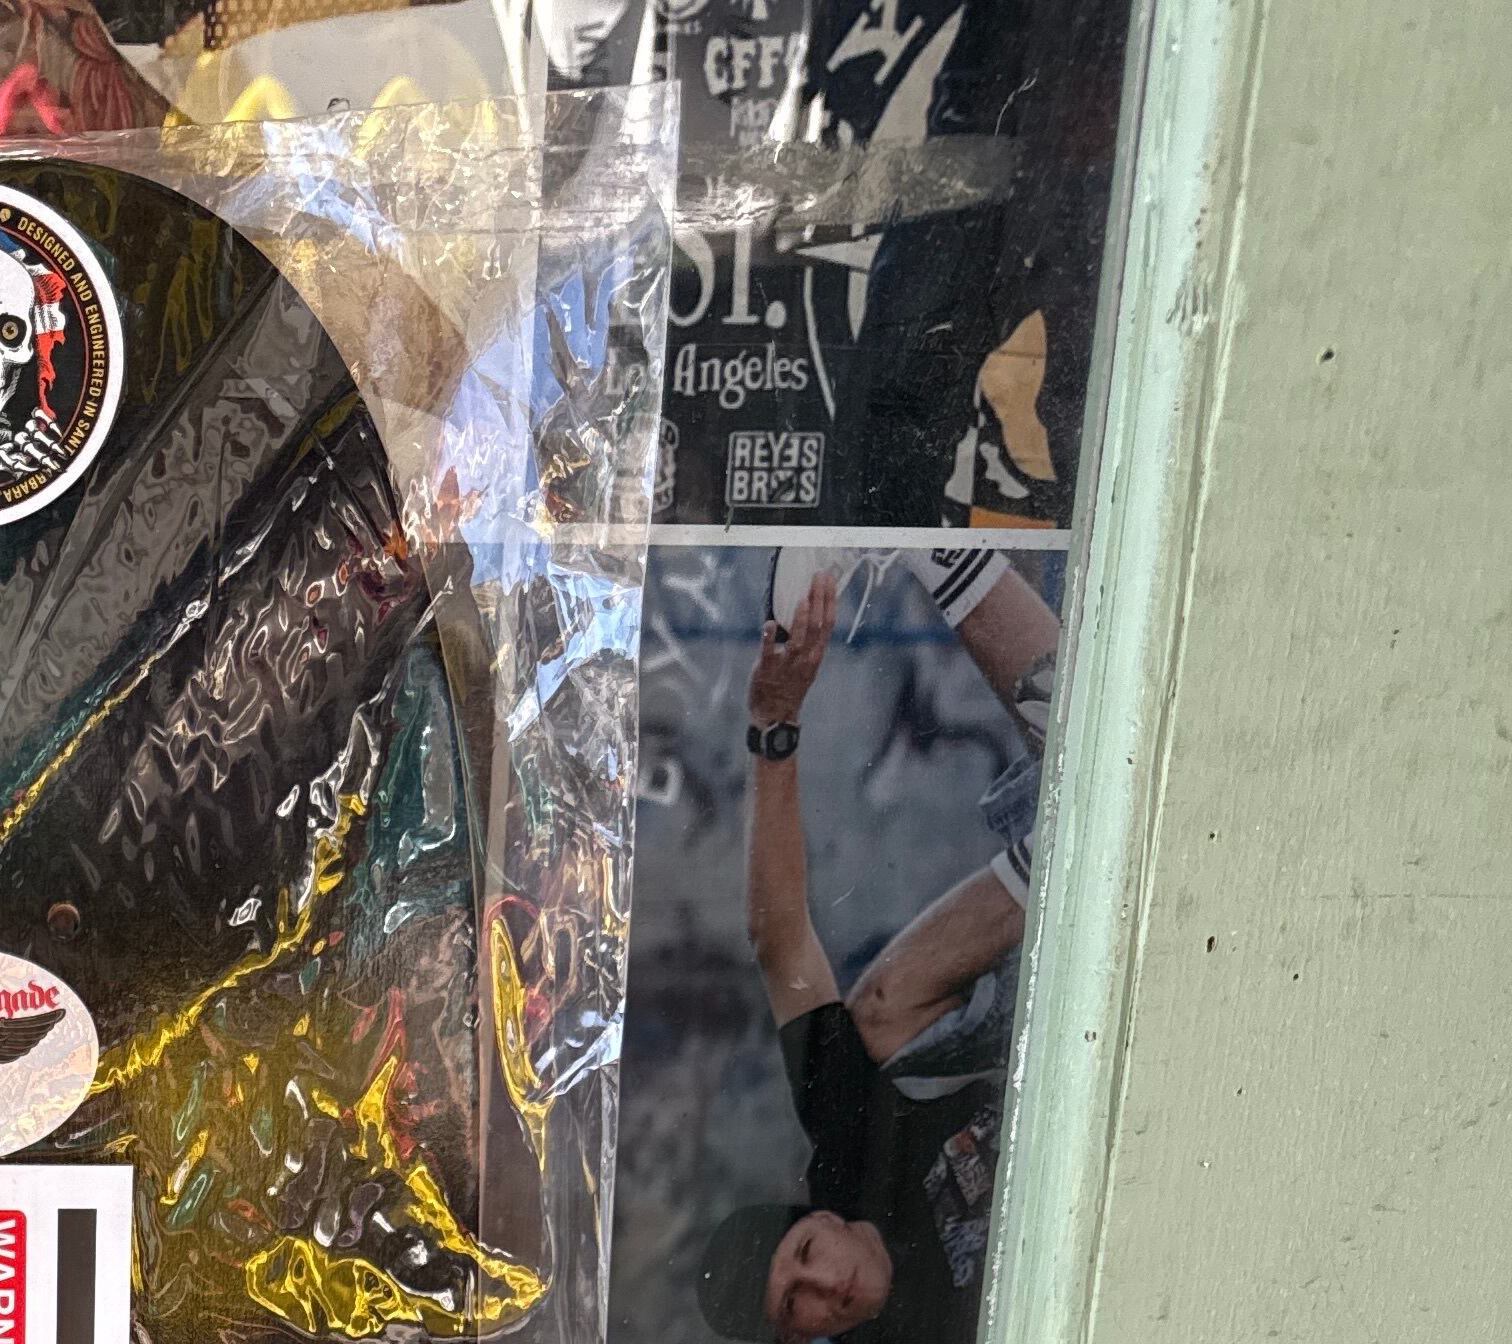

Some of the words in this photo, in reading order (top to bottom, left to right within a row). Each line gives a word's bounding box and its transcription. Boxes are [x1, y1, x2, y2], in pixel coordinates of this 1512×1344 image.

[16, 216, 75, 272] DESIGNED
[70, 272, 93, 302] AND
[84, 303, 105, 396] ENGINEERED
[673, 340, 808, 409] Angeles
[83, 402, 98, 418] IN
[64, 419, 90, 456] SANT
